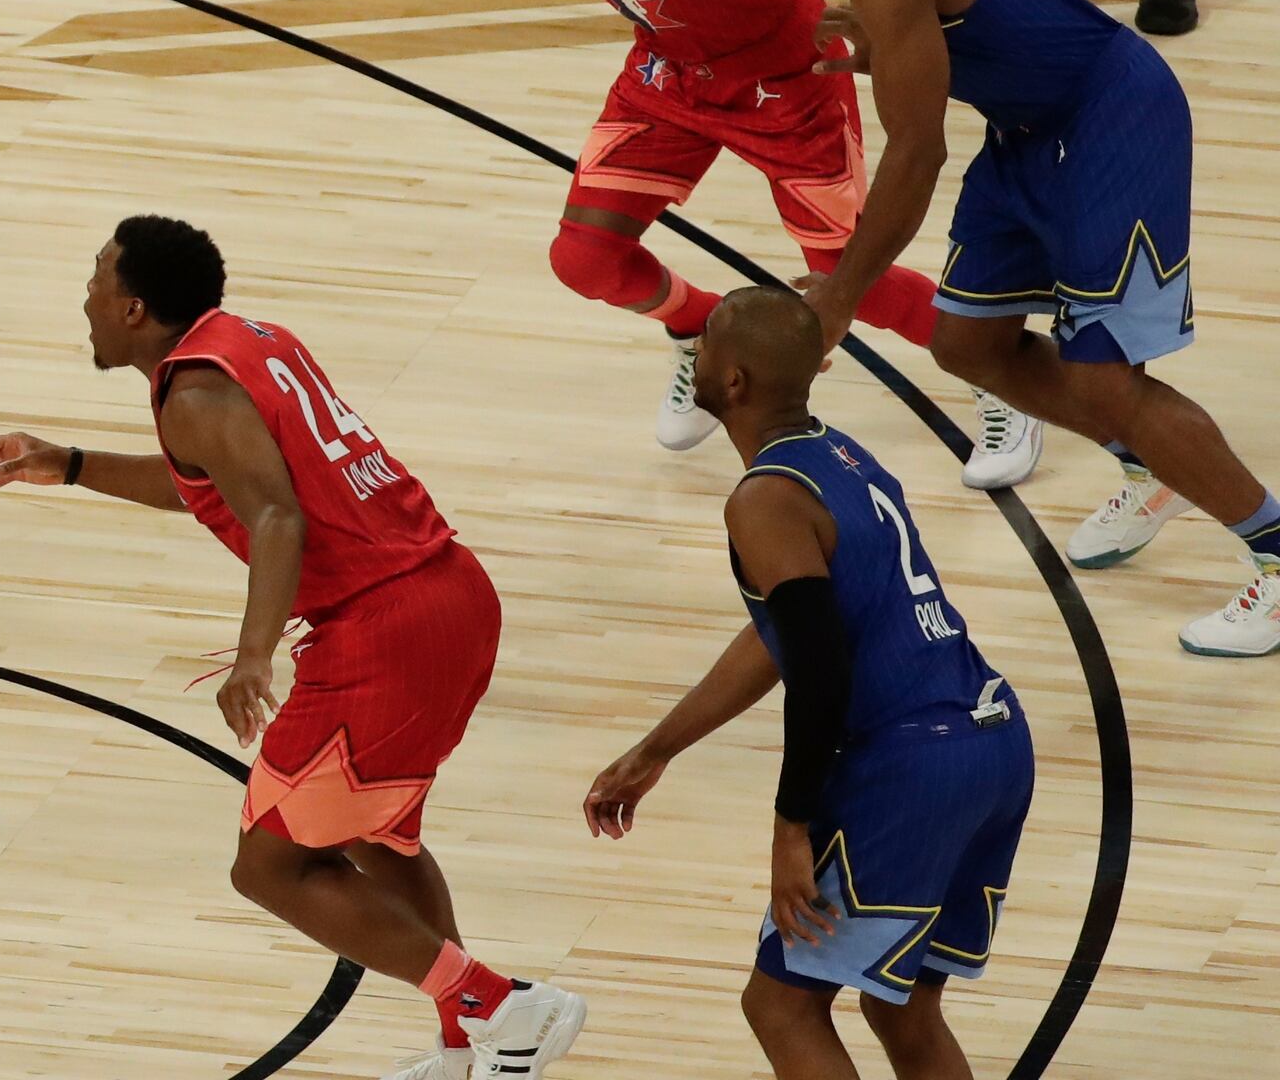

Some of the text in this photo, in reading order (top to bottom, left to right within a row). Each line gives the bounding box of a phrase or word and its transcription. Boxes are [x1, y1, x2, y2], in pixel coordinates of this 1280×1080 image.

[265, 348, 376, 463] 24
[868, 483, 937, 596] 2
[914, 600, 961, 658] PAUL
